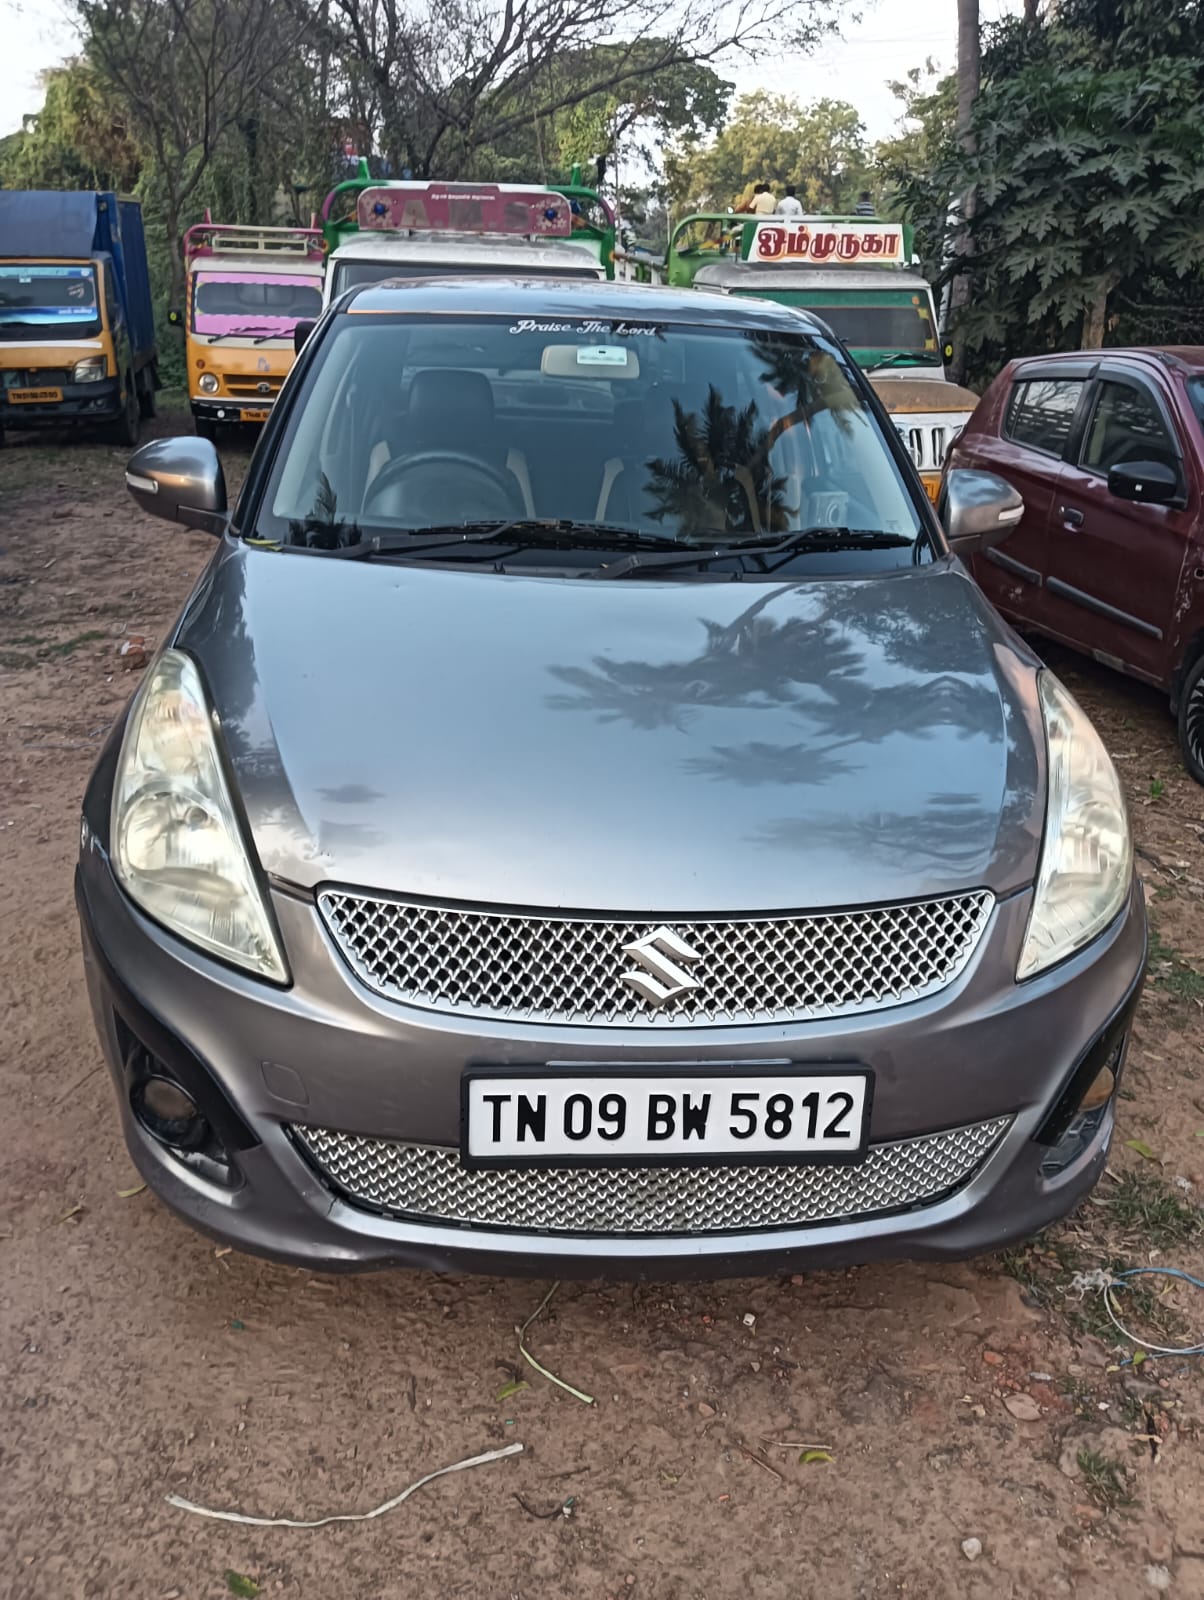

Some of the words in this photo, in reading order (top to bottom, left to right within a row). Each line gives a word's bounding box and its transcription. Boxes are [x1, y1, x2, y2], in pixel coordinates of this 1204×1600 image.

[509, 319, 571, 335] Praise
[576, 320, 611, 335] The
[616, 322, 657, 337] Lord
[483, 1094, 547, 1142] TN
[563, 1093, 627, 1140] 09
[647, 1093, 711, 1141] BW
[729, 1091, 854, 1140] 5812
